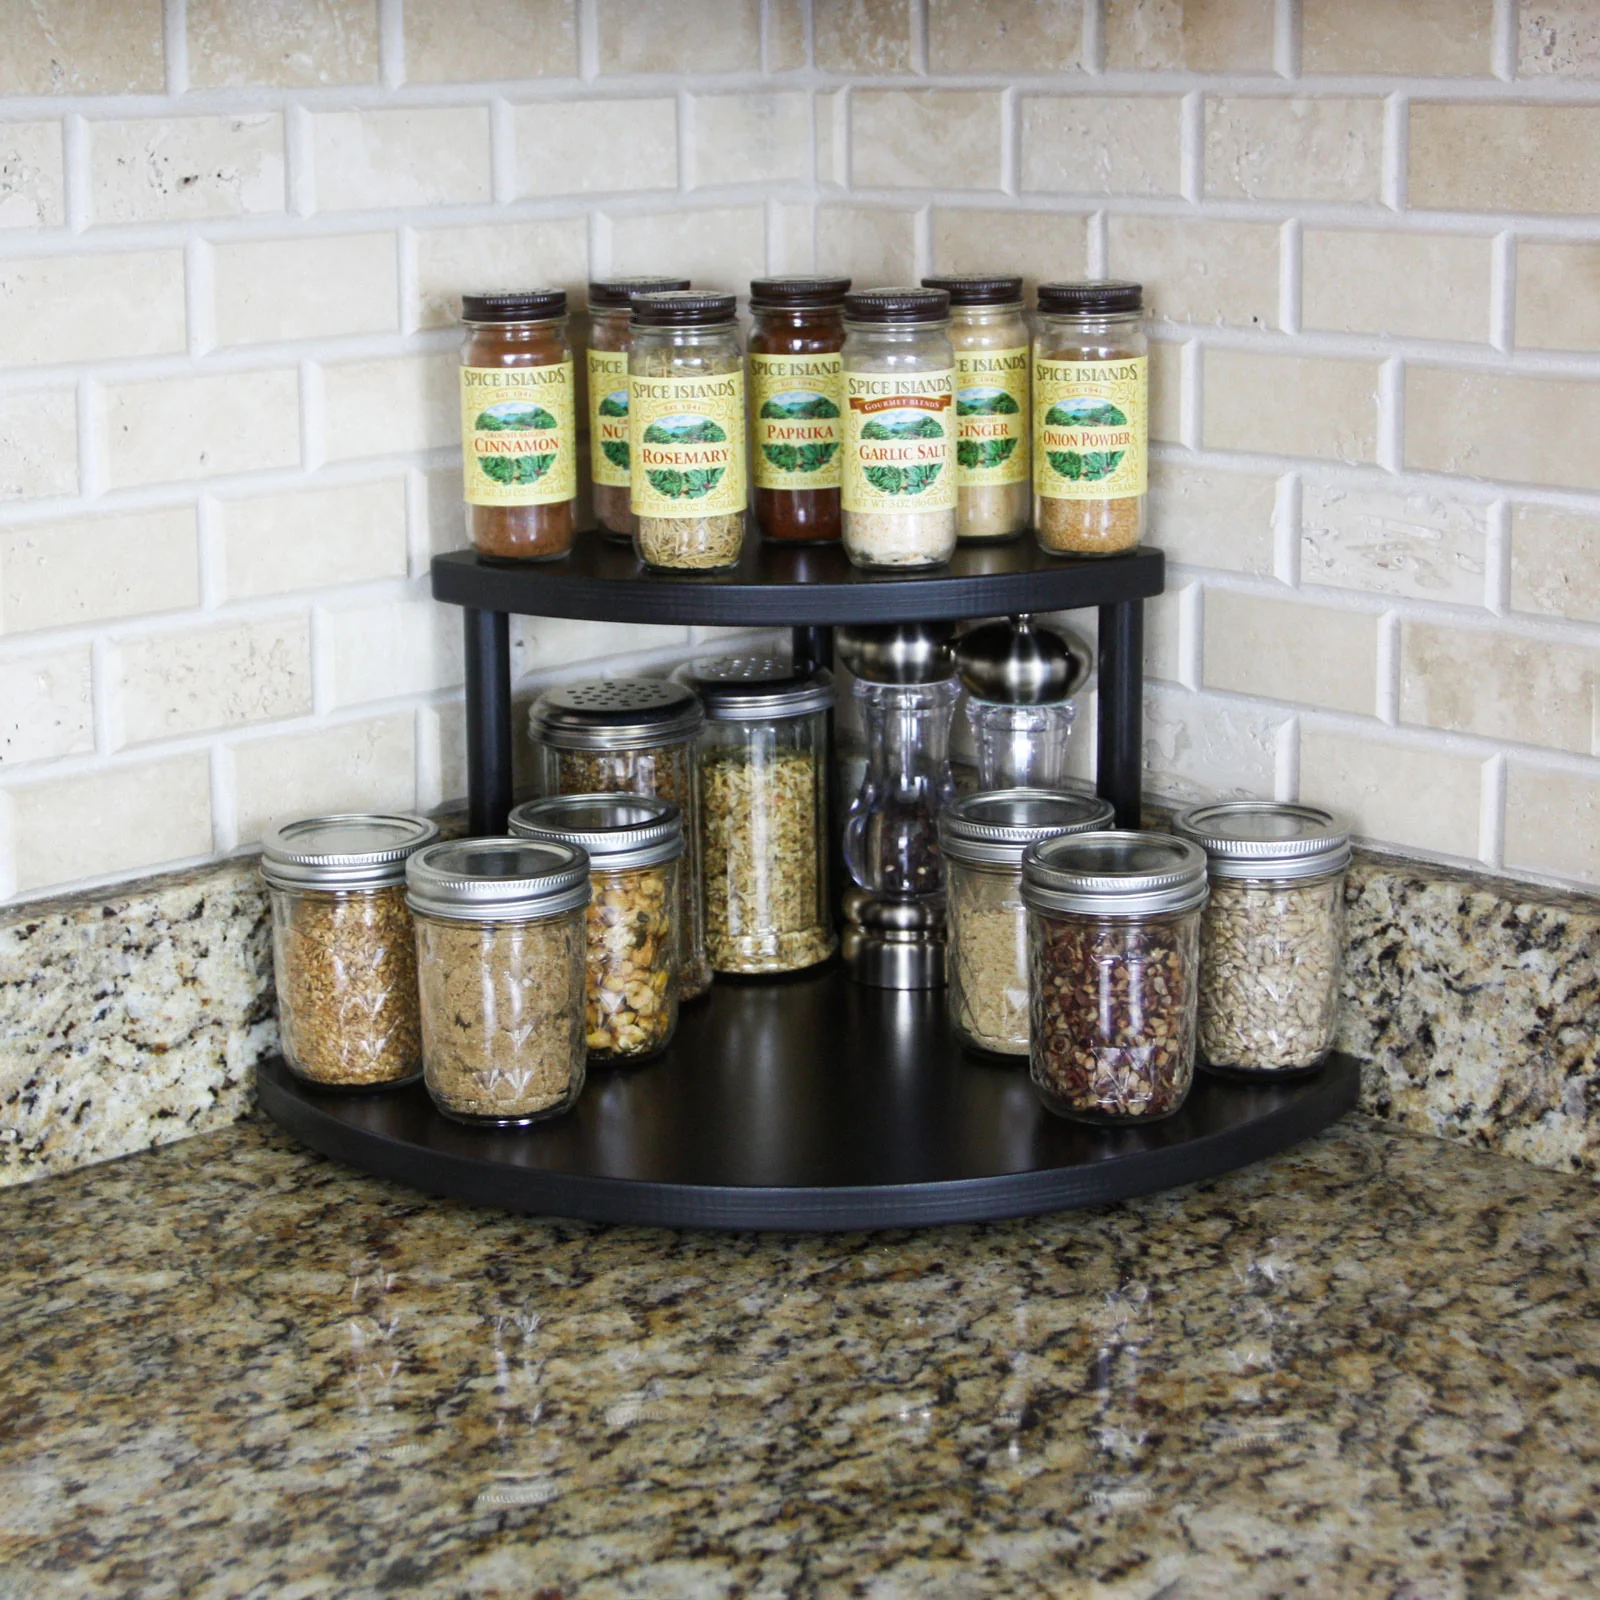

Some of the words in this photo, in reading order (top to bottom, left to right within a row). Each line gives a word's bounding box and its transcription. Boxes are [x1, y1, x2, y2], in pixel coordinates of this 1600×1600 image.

[590, 357, 623, 373] SPICE
[751, 359, 785, 376] SPICE
[788, 361, 840, 376] ISLAND
[972, 353, 1027, 372] ISLANDS
[464, 370, 500, 387] SPICE
[505, 367, 566, 386] ISLANDS
[1036, 363, 1072, 381] SPICE
[1076, 363, 1138, 381] ISLANDS
[632, 381, 670, 399] SPICE
[673, 379, 736, 399] ISLANDS
[848, 377, 889, 395] SPICE
[895, 375, 952, 394] ISLANDS
[864, 398, 907, 411] GOURMET
[909, 399, 940, 408] BLENDS
[767, 424, 834, 439] PAPRIKA
[1043, 430, 1078, 447] ONION
[1081, 431, 1131, 447] POWDER
[474, 436, 559, 453] CINNAMON
[859, 444, 913, 461] GARLIC
[917, 444, 947, 460] SALT
[642, 448, 730, 465] ROSEMARY
